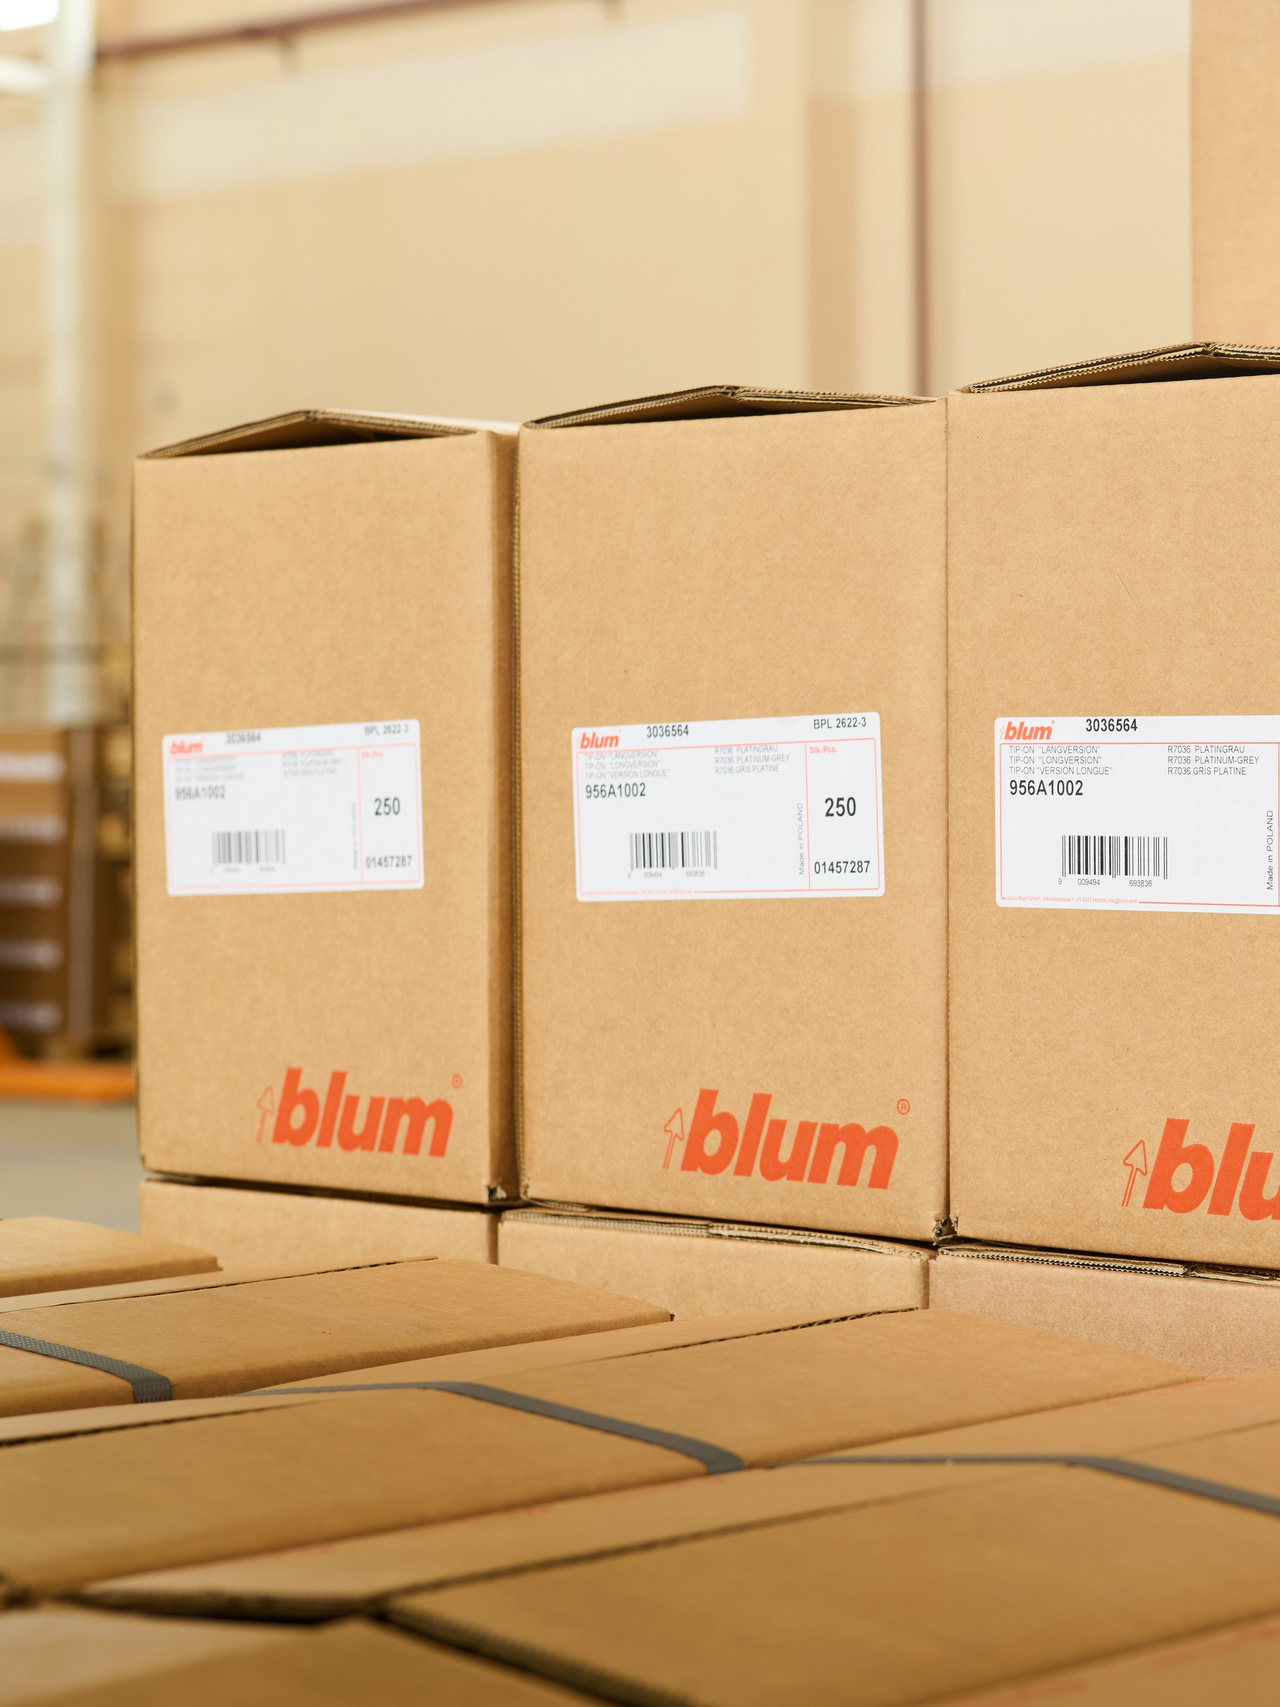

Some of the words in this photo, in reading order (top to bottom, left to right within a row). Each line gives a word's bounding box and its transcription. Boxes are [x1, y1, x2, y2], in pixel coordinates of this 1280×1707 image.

[813, 719, 832, 729] BPL
[836, 717, 866, 728] 2622-3
[1085, 718, 1138, 732] 3036564
[364, 726, 380, 735] BPL
[646, 724, 689, 738] 3036564
[1004, 721, 1053, 740] blum
[580, 732, 619, 749] blum
[1009, 745, 1035, 754] TIP-ON
[1167, 745, 1191, 754] R7036
[1194, 745, 1245, 754] PLATINGRAU
[1009, 756, 1035, 764] TIP-ON
[1167, 756, 1191, 764] R7036
[1194, 756, 1260, 764] PLATINUM-GREY
[1009, 766, 1035, 775] TIP-ON
[1167, 767, 1191, 775] R7036
[1192, 767, 1212, 775] GRIS
[1213, 767, 1247, 775] PLATINE
[585, 783, 646, 798] 956A1002
[1009, 779, 1084, 796] 956A1002
[374, 797, 400, 816] 250
[825, 797, 856, 817] 250
[366, 855, 412, 868] 01457287
[1267, 855, 1273, 863] in
[814, 860, 870, 874] 01457287
[1078, 878, 1100, 886] 009494
[272, 1068, 453, 1157] blum
[681, 1089, 898, 1189] blum
